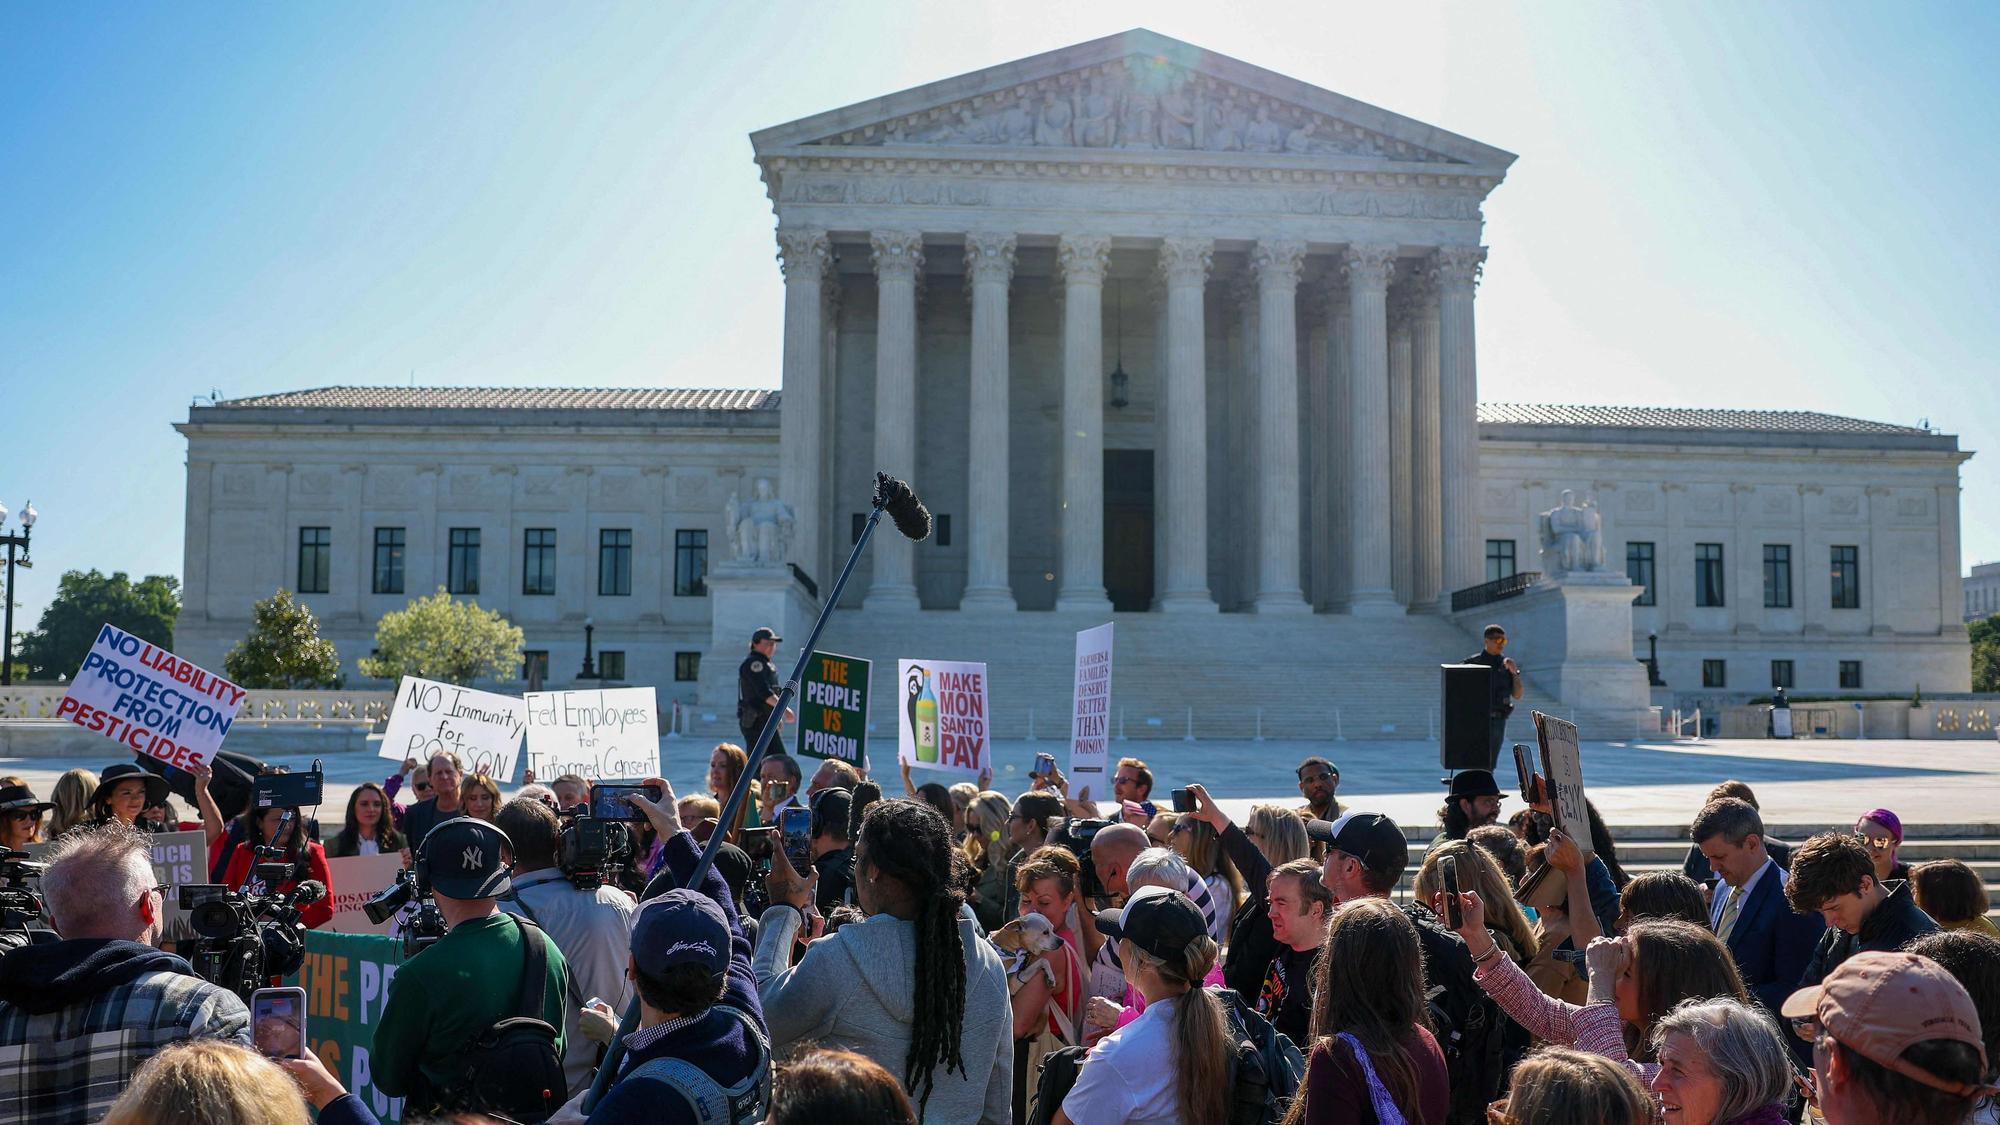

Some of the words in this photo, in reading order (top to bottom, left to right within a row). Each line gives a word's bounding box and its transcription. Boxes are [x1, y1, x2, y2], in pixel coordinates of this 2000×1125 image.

[97, 625, 140, 656] NO
[139, 645, 246, 706] LIABILITY
[821, 659, 849, 684] THE
[1080, 665, 1109, 681] FAMILIES
[82, 652, 233, 736] PROTECTION
[939, 671, 982, 693] MAKE
[1079, 681, 1107, 697] DESERVE
[807, 681, 861, 712] PEOPLE
[940, 691, 983, 718] MON
[1078, 698, 1107, 714] BETTER
[112, 693, 182, 739] FROM
[405, 681, 442, 713] NO
[443, 687, 523, 740] Immunity
[527, 693, 557, 726] Fed
[564, 690, 648, 735] Employees
[822, 708, 842, 733] VS
[56, 697, 204, 771] PESTICIDES
[577, 731, 600, 748] for
[941, 716, 984, 737] SANTO
[1077, 715, 1106, 737] THAN
[804, 728, 858, 761] POISON
[941, 734, 984, 770] PAY
[528, 752, 600, 780] Informed
[604, 746, 658, 776] Consent
[462, 846, 483, 870] NY
[172, 864, 193, 884] IS
[297, 952, 349, 1021] THE
